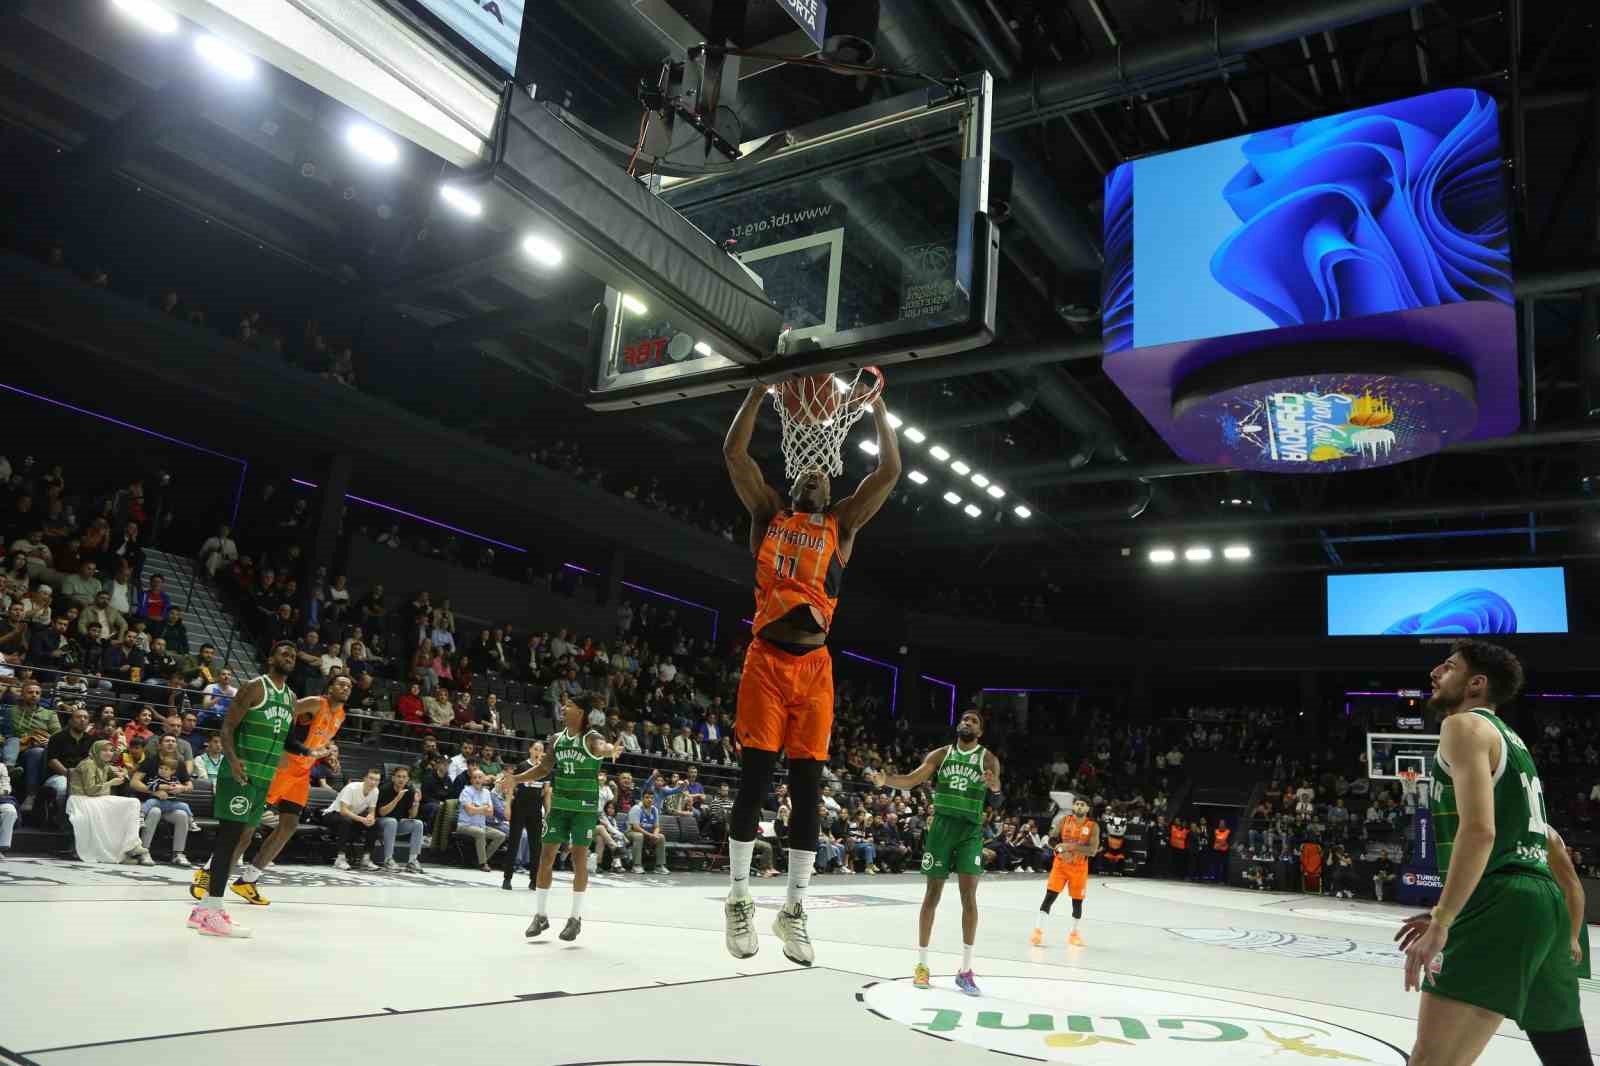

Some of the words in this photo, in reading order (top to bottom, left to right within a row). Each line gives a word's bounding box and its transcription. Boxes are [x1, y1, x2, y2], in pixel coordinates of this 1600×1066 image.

[776, 554, 799, 578] 11
[273, 718, 281, 733] 2
[563, 761, 575, 774] 31
[949, 775, 968, 791] 22
[911, 1007, 1249, 1042] Glint
